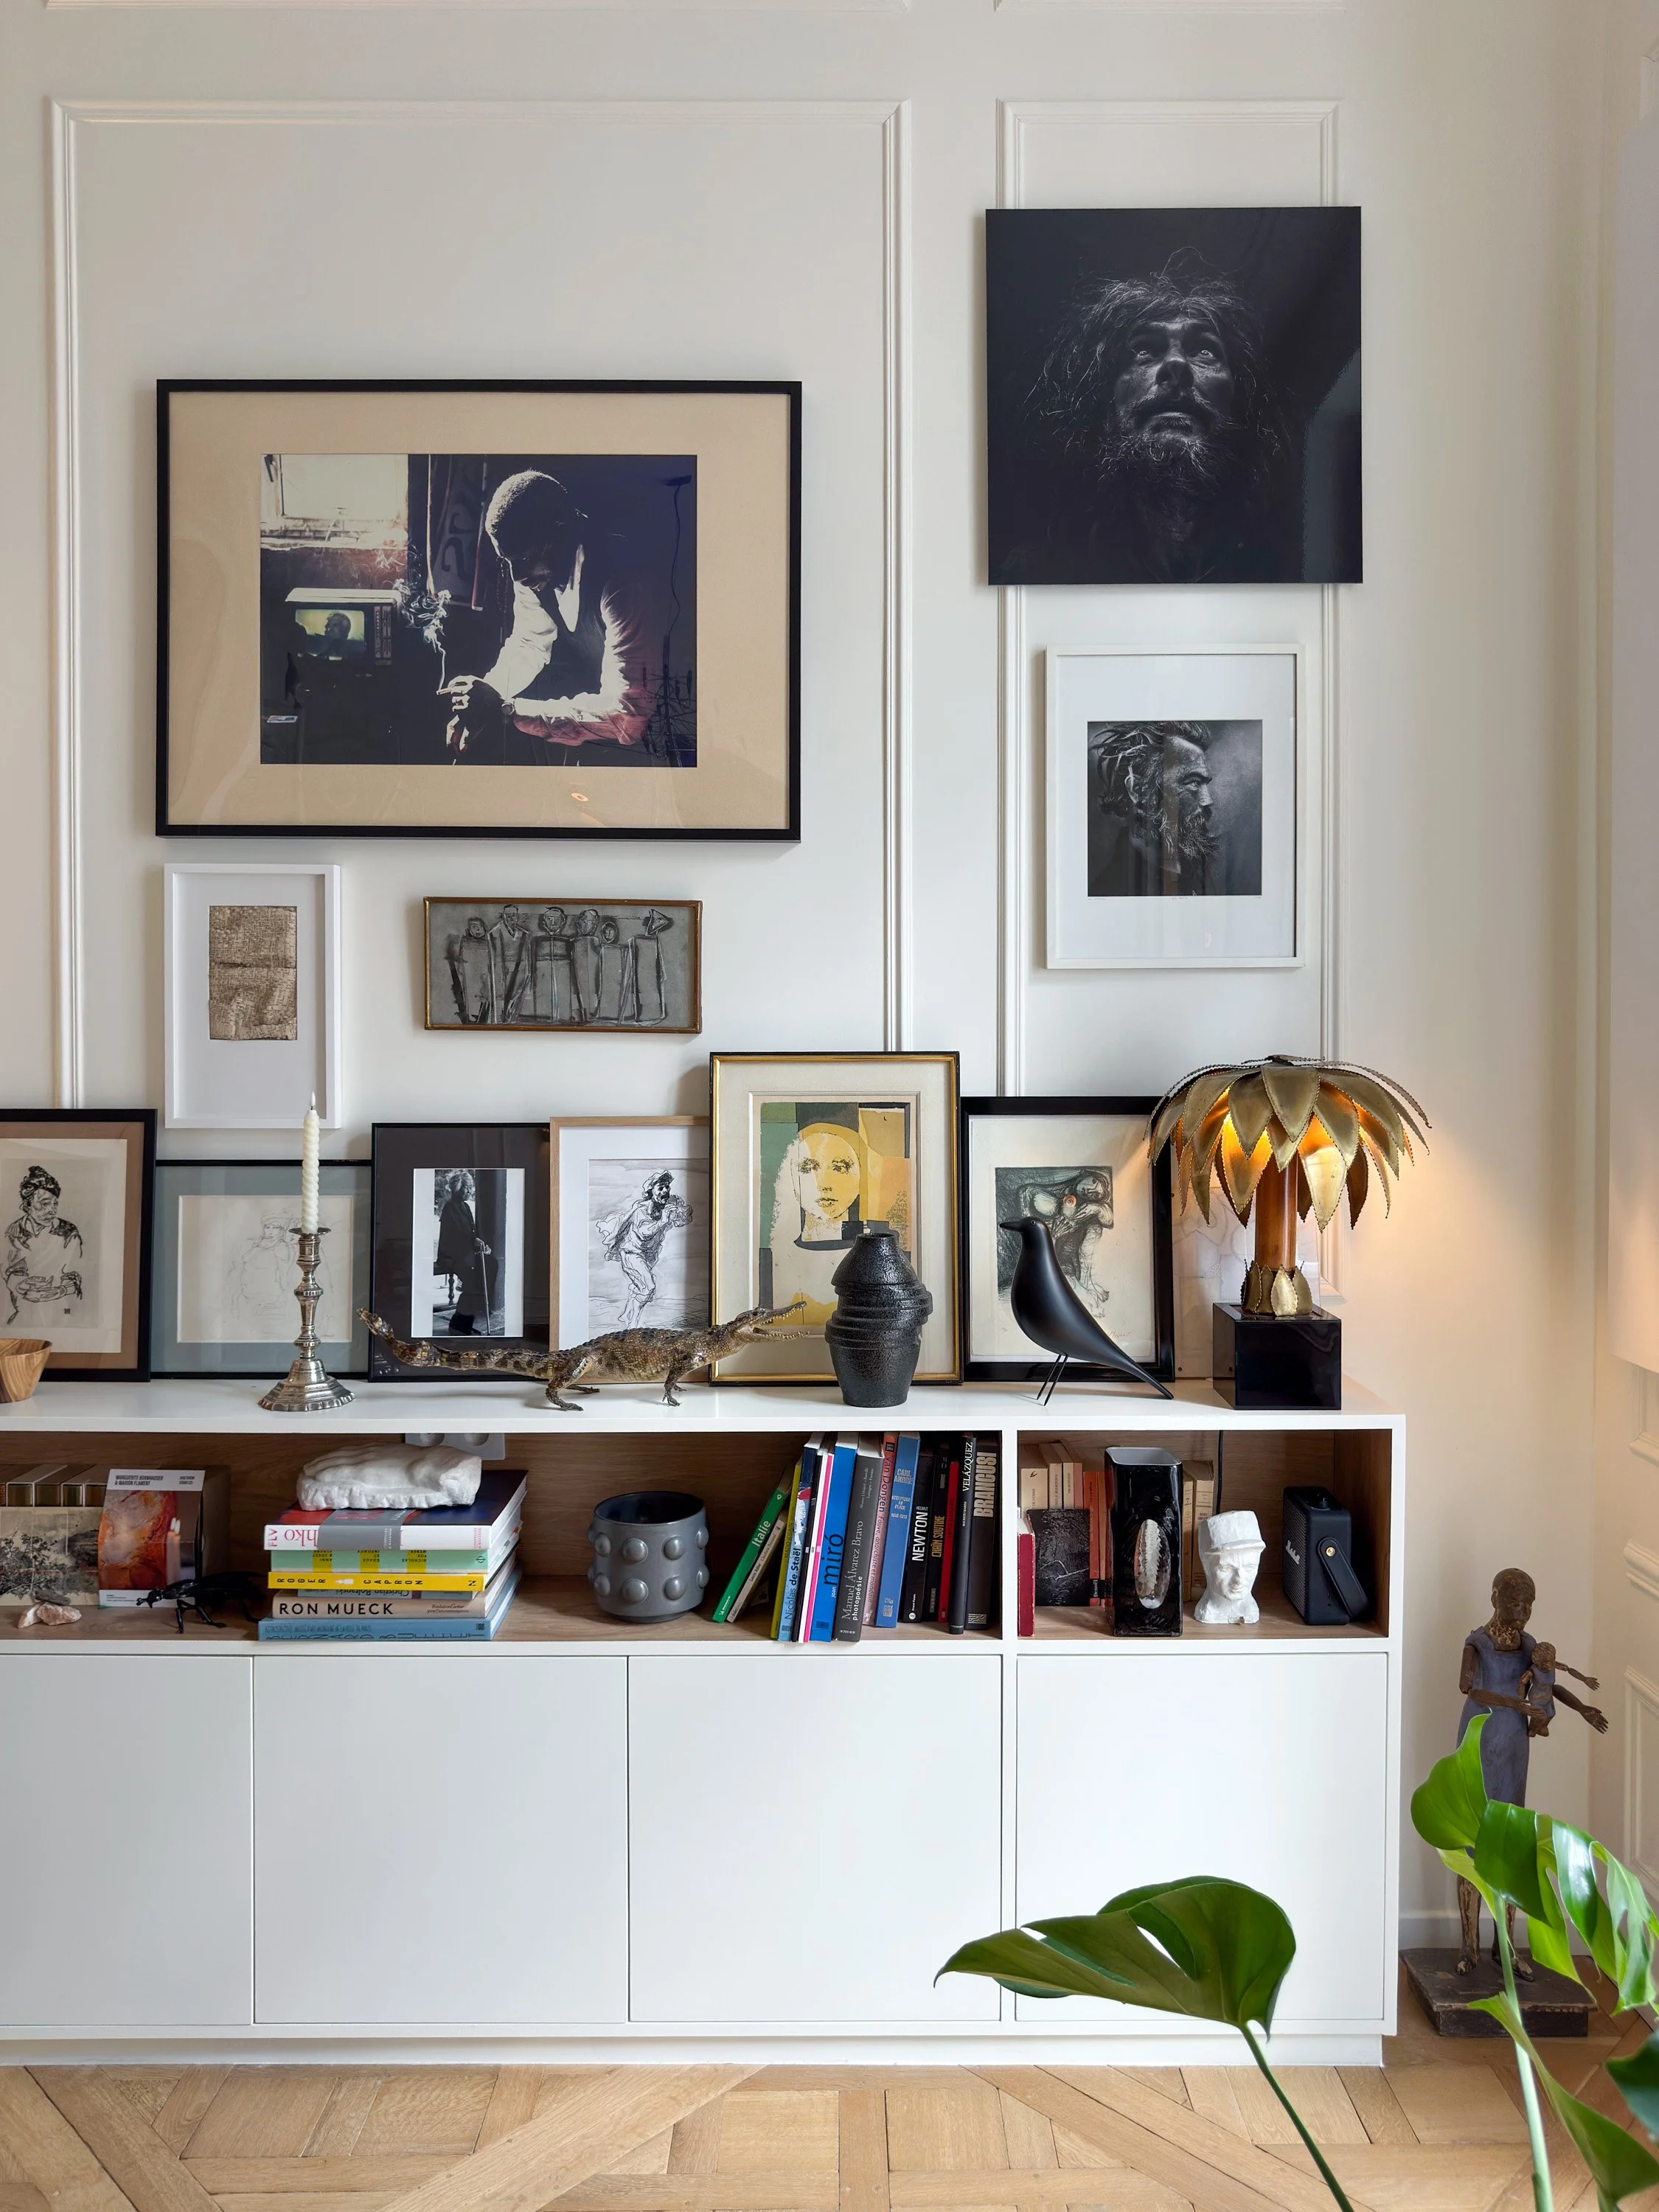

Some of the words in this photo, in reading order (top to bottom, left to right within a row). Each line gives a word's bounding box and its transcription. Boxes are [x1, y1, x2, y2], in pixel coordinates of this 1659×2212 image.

[897, 1468, 911, 1476] CARL
[962, 1441, 974, 1492] VELÁZQUEZ
[878, 1475, 891, 1512] Dongen
[973, 1451, 997, 1517] BRANCUSI
[751, 1520, 771, 1547] Italie
[852, 1520, 863, 1547] Bravo
[911, 1512, 928, 1562] NEWTON
[933, 1515, 945, 1539] SOUTINE
[791, 1548, 801, 1571] Staël
[821, 1534, 844, 1586] miró
[844, 1548, 860, 1582] Álvarez
[789, 1572, 797, 1586] de
[279, 1603, 319, 1615] RON
[327, 1603, 393, 1615] MUECK
[784, 1589, 796, 1620] Nicolas
[842, 1585, 855, 1620] Manuel
[852, 1576, 863, 1621] photopoésie
